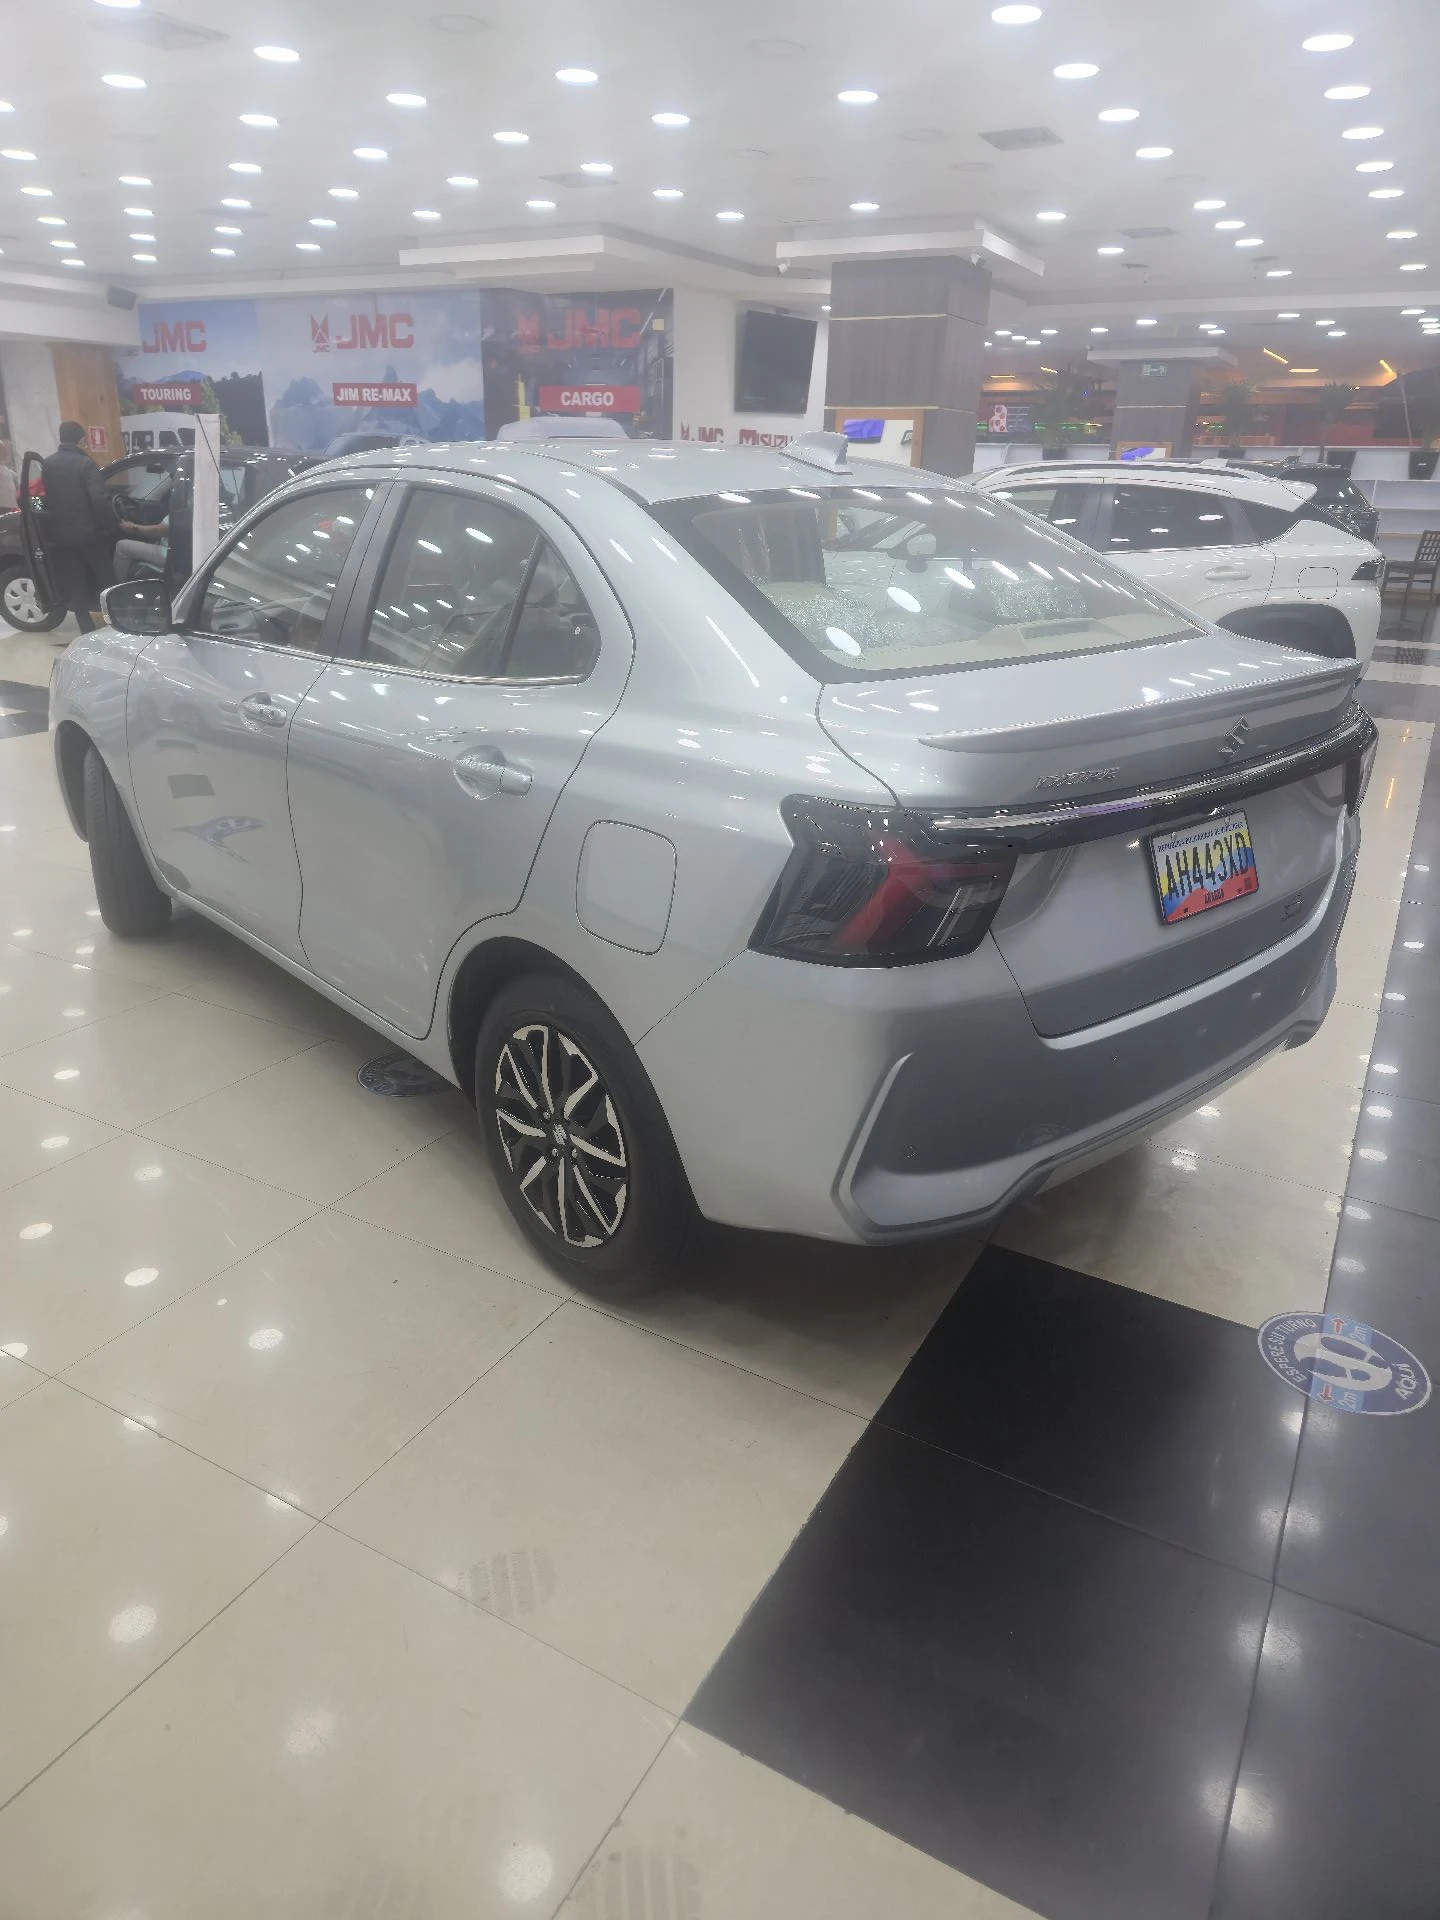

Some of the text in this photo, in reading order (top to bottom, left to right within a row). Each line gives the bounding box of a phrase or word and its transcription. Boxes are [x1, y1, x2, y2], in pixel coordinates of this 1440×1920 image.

[142, 320, 207, 353] JMC
[335, 312, 415, 349] JMC
[547, 308, 641, 351] JMC
[140, 388, 192, 401] TOURING
[337, 388, 412, 402] JIM RE-MAX
[560, 391, 614, 406] CARGO
[1165, 832, 1249, 901] AH443XD
[1268, 1318, 1317, 1383] ESPERE SU TURNO
